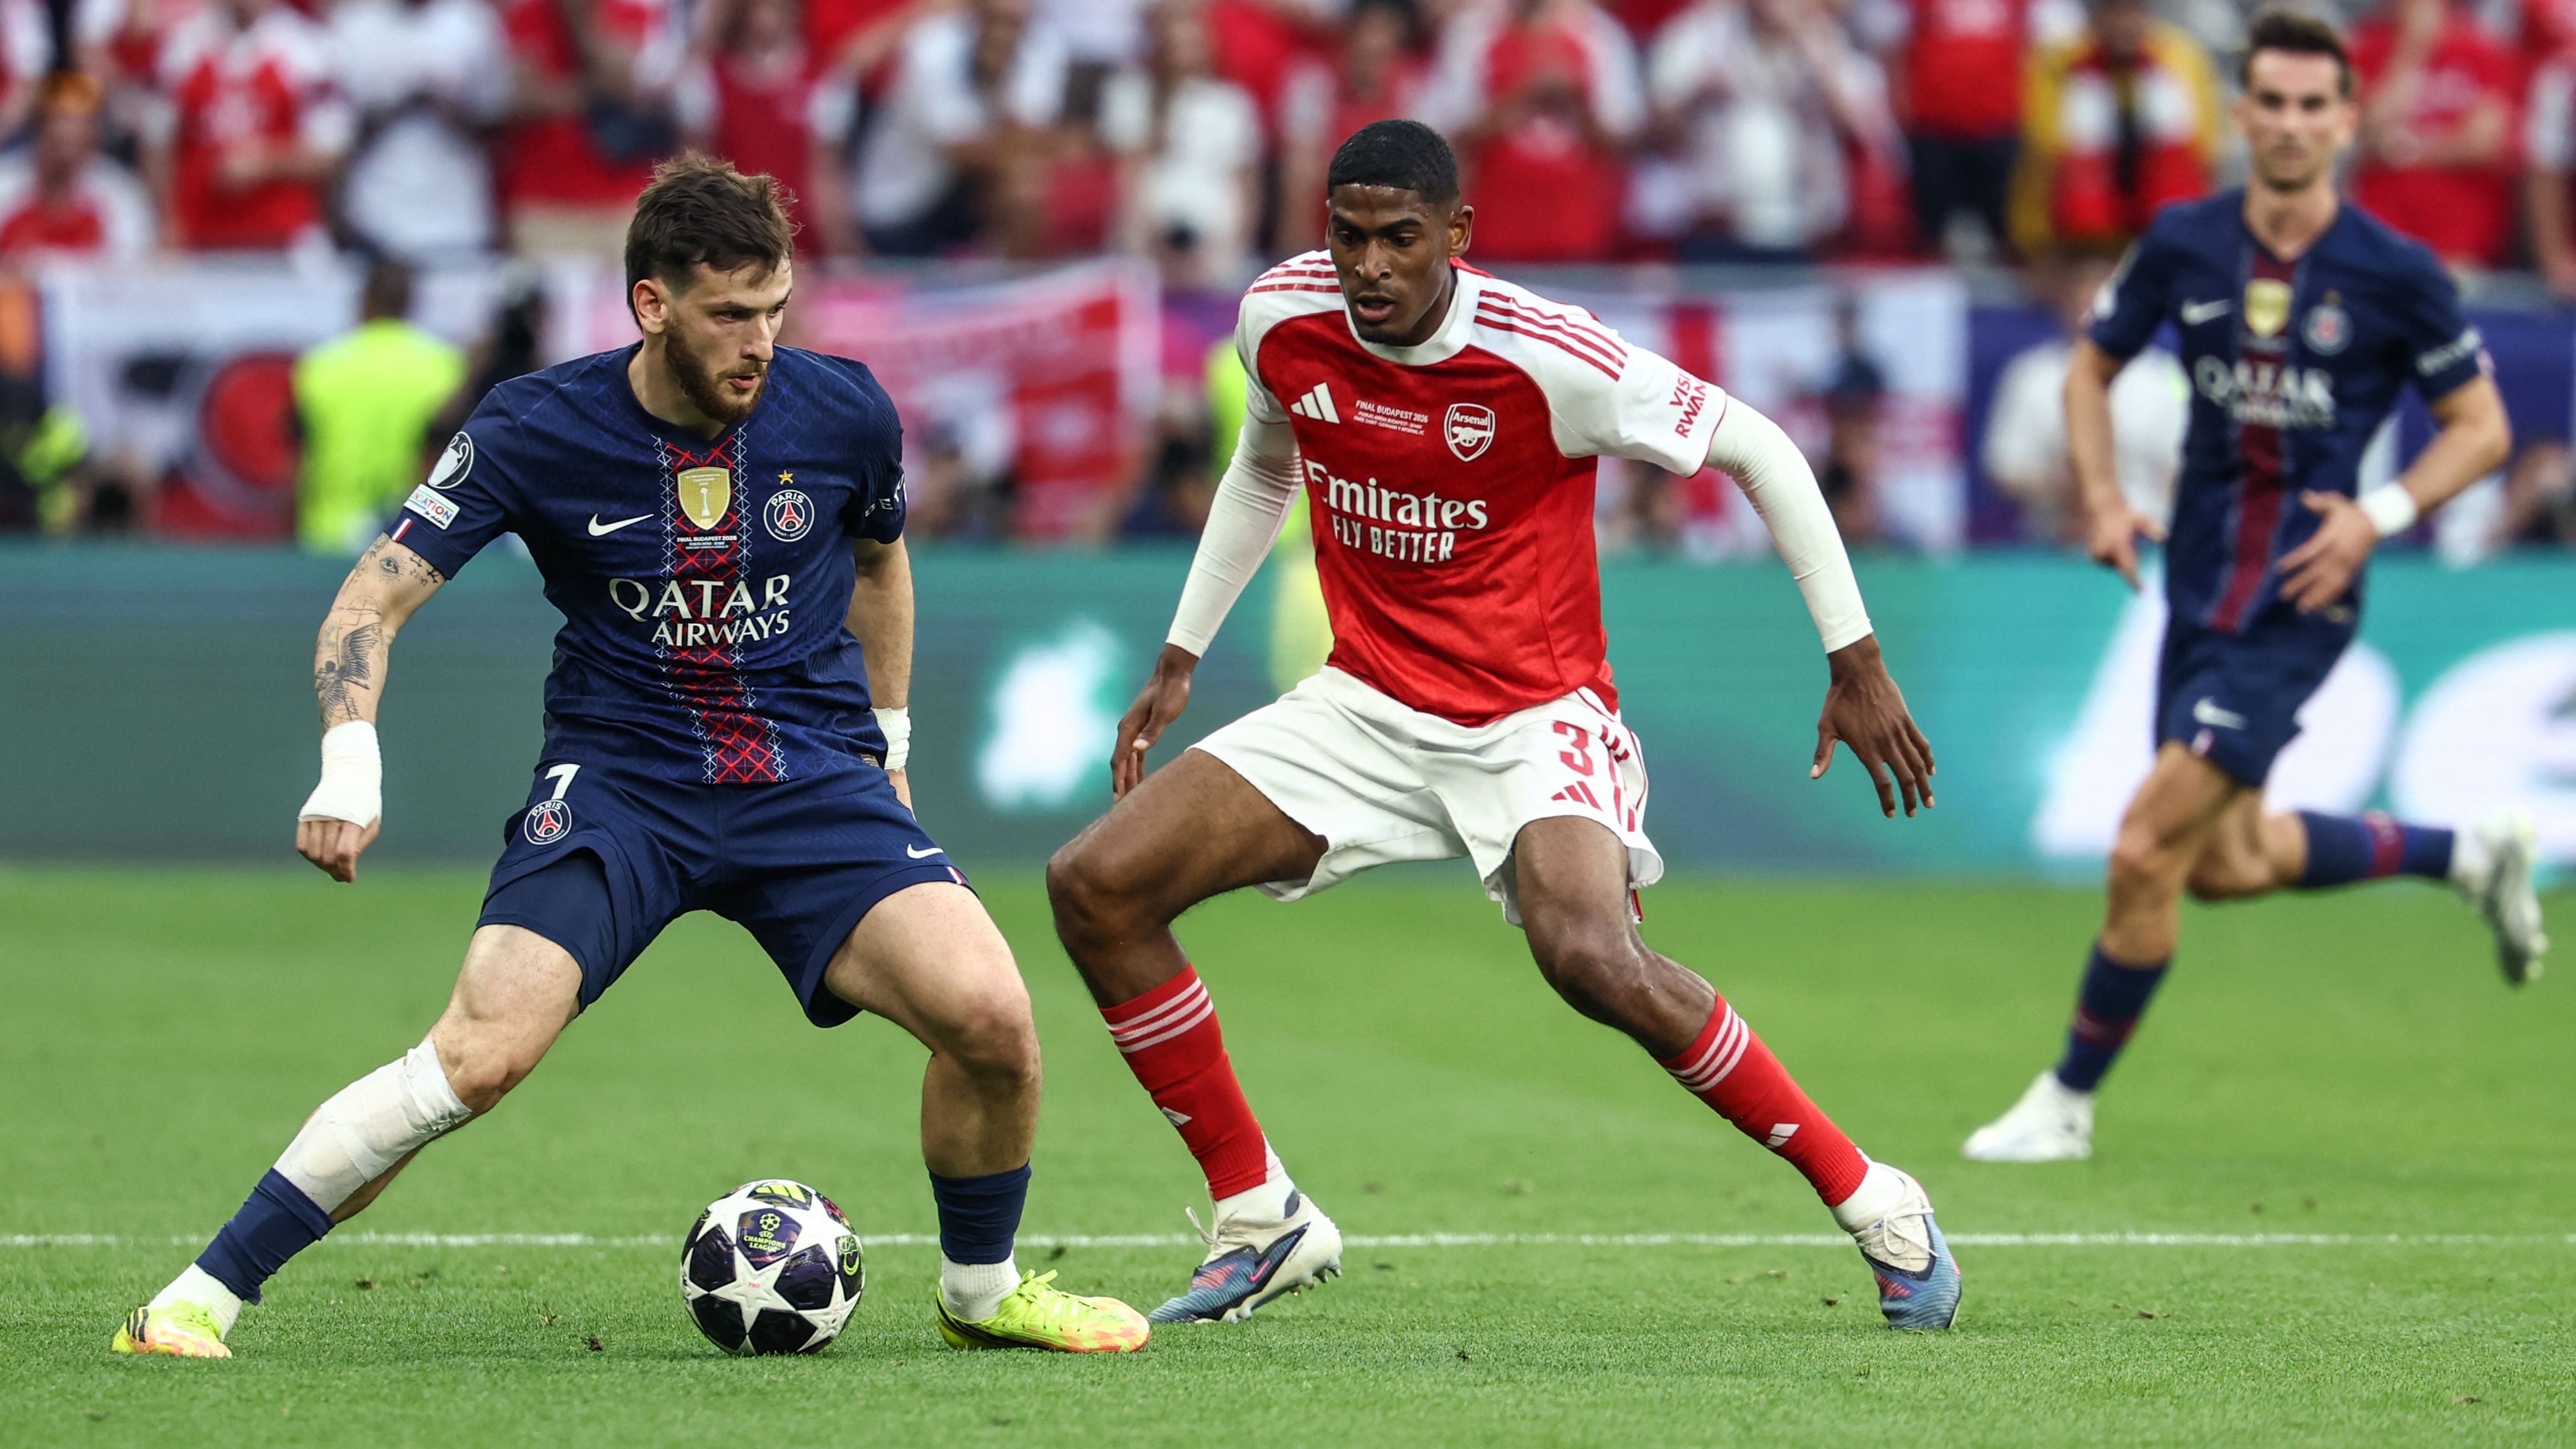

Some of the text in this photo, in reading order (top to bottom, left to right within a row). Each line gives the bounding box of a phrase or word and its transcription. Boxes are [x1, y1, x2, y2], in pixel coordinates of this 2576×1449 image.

[1669, 372, 1691, 407] VISI
[1356, 400, 1375, 412] FINAL
[1377, 405, 1413, 420] BUDAPEST
[1453, 412, 1488, 426] Arsenal
[1675, 380, 1707, 438] RWAN
[771, 492, 805, 507] PARIS
[1305, 459, 1488, 530] Emirates
[1332, 514, 1455, 563] FLY BETTER
[609, 574, 790, 622] QATAR
[651, 610, 790, 647] AIRWAYS
[1552, 720, 1594, 777] 3
[545, 763, 581, 800] 7
[532, 802, 562, 817] PARIS
[743, 1235, 786, 1248] CHAMPIONS
[749, 1242, 778, 1253] LEAGUE
